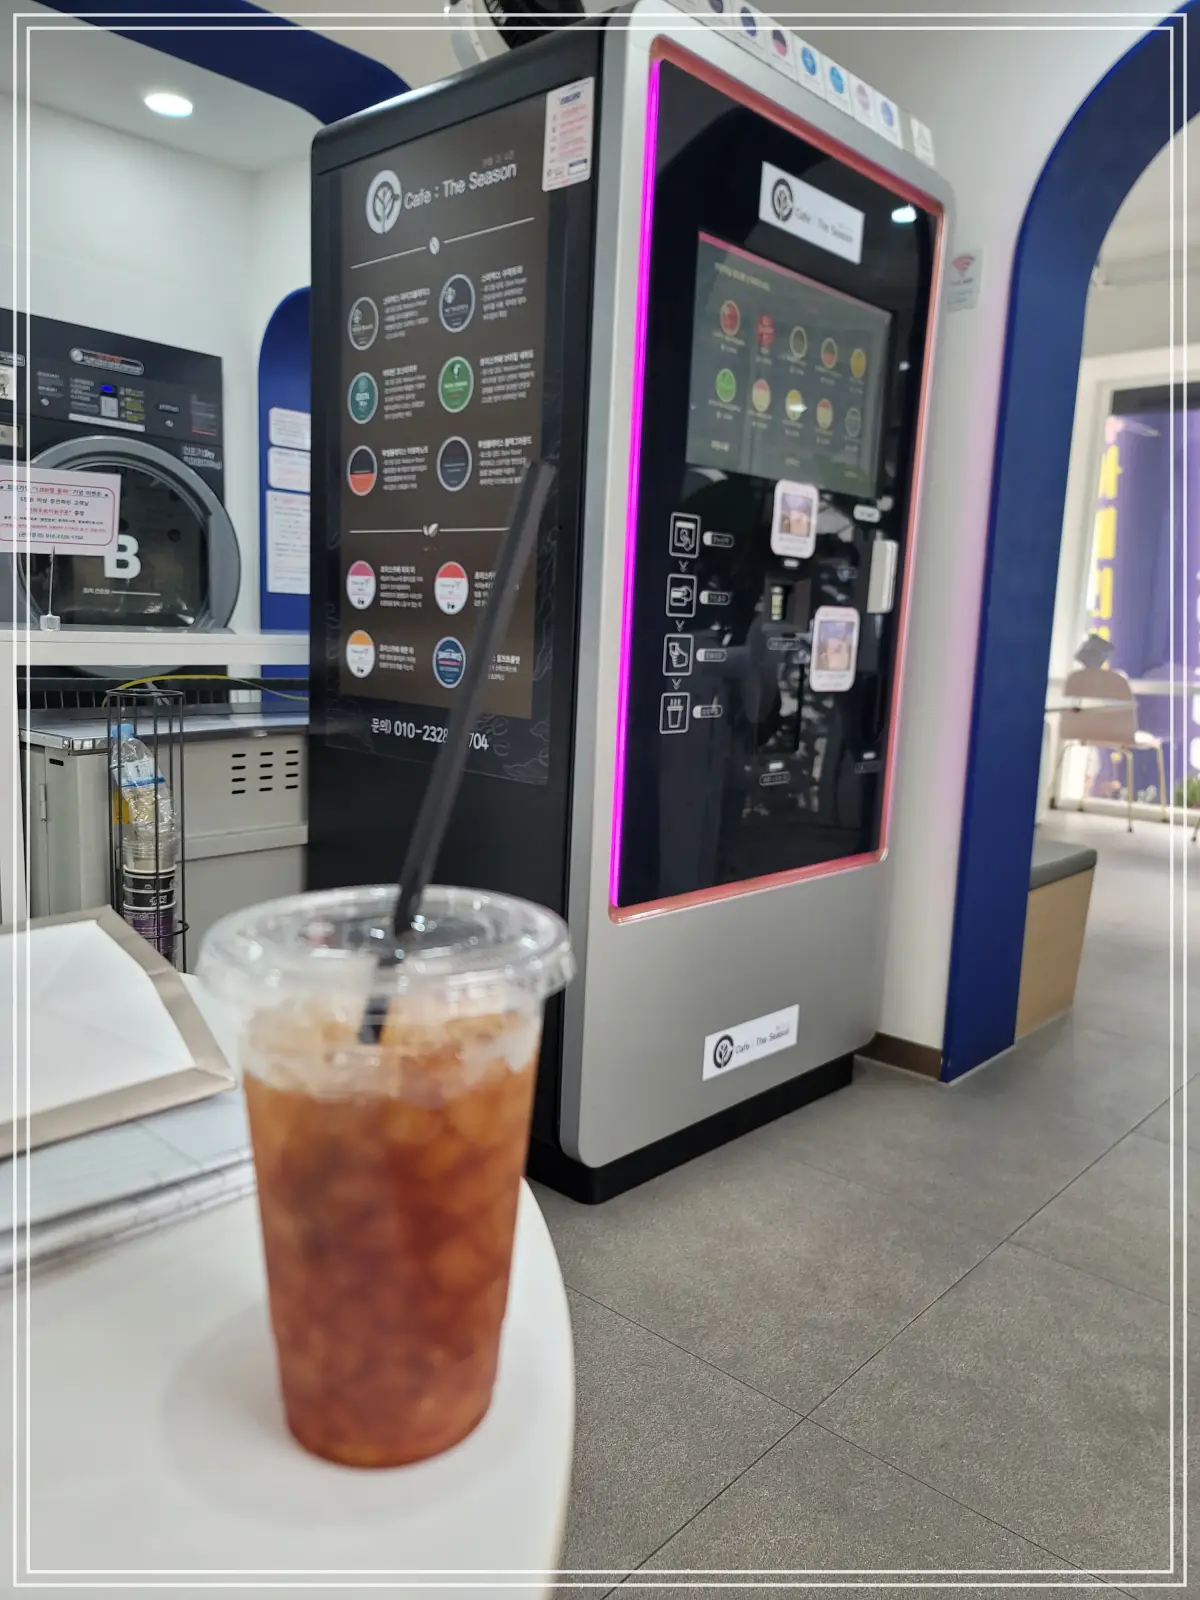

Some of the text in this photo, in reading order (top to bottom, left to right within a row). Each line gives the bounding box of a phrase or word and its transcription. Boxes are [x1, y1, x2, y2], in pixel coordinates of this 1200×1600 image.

[403, 187, 432, 210] Cafe
[442, 178, 466, 198] The
[468, 163, 518, 190] Season
[104, 534, 141, 579] B
[371, 717, 392, 735] 문의)
